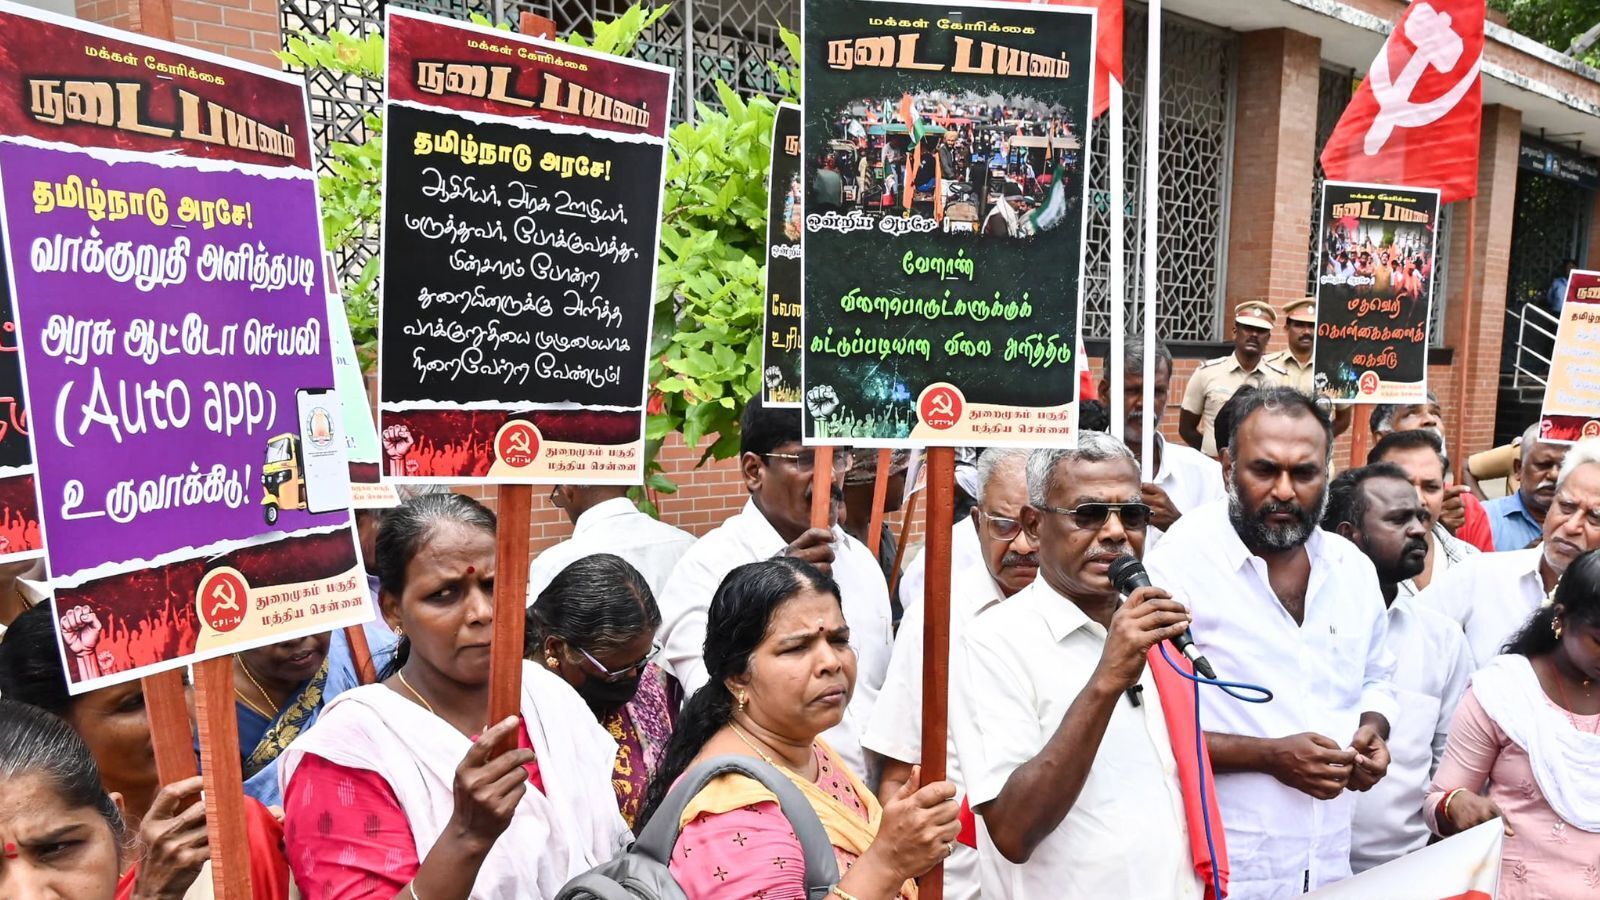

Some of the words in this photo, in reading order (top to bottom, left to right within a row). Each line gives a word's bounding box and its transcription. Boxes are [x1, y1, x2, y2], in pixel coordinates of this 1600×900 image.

[868, 16, 930, 30] மக்கள்
[936, 17, 1036, 35] கோரிக்கை
[85, 45, 138, 67] மக்கள்
[145, 55, 226, 86] கோரிக்கை
[467, 38, 514, 56] மக்கள்
[517, 47, 589, 72] கோரிக்கை
[827, 33, 946, 71] நடை
[951, 35, 1070, 79] பயணம்
[417, 61, 536, 108] நடை
[540, 72, 650, 128] பயணம்
[29, 79, 177, 138] நடை
[178, 88, 296, 158] பயணம்
[414, 129, 532, 173] தமிழ்நாடு
[540, 152, 612, 181] அரசே!
[32, 174, 169, 226] தமிழ்நாடு
[177, 194, 253, 229] அரசே!
[422, 167, 502, 207] ஆசிரியர்,
[508, 181, 550, 214] அரசு
[555, 190, 628, 225] ஊழியர்,
[404, 212, 507, 244] மருத்துவர்,
[514, 216, 639, 264] போக்குவரத்து,
[806, 210, 874, 236] ஒன்றிய
[30, 225, 190, 292] வாக்குறுதி
[197, 240, 315, 296] அளித்தபடி
[450, 249, 525, 280] மின்சாரம்
[530, 252, 600, 292] போன்ற
[902, 248, 974, 281] வேளாண்
[418, 285, 553, 316] துறையினருக்கு
[563, 289, 623, 328] அளித்த
[1347, 292, 1407, 319] மதவெறி
[41, 313, 116, 366] அரசு
[124, 312, 238, 366] ஆட்டோ
[243, 317, 321, 356] செயலி
[403, 318, 530, 351] வாக்குறுதியை
[535, 331, 631, 352] முழுமையாக
[810, 327, 930, 361] கட்டுப்படியான
[944, 331, 992, 357] விலை
[1003, 332, 1071, 368] அளித்திடு
[413, 346, 530, 384] நிறைவேற்ற
[535, 352, 620, 388] வேண்டும்!
[1352, 346, 1398, 369] கைவிடு
[55, 366, 191, 447] (Auto
[203, 380, 277, 437] app)
[211, 615, 242, 629] CPI-M
